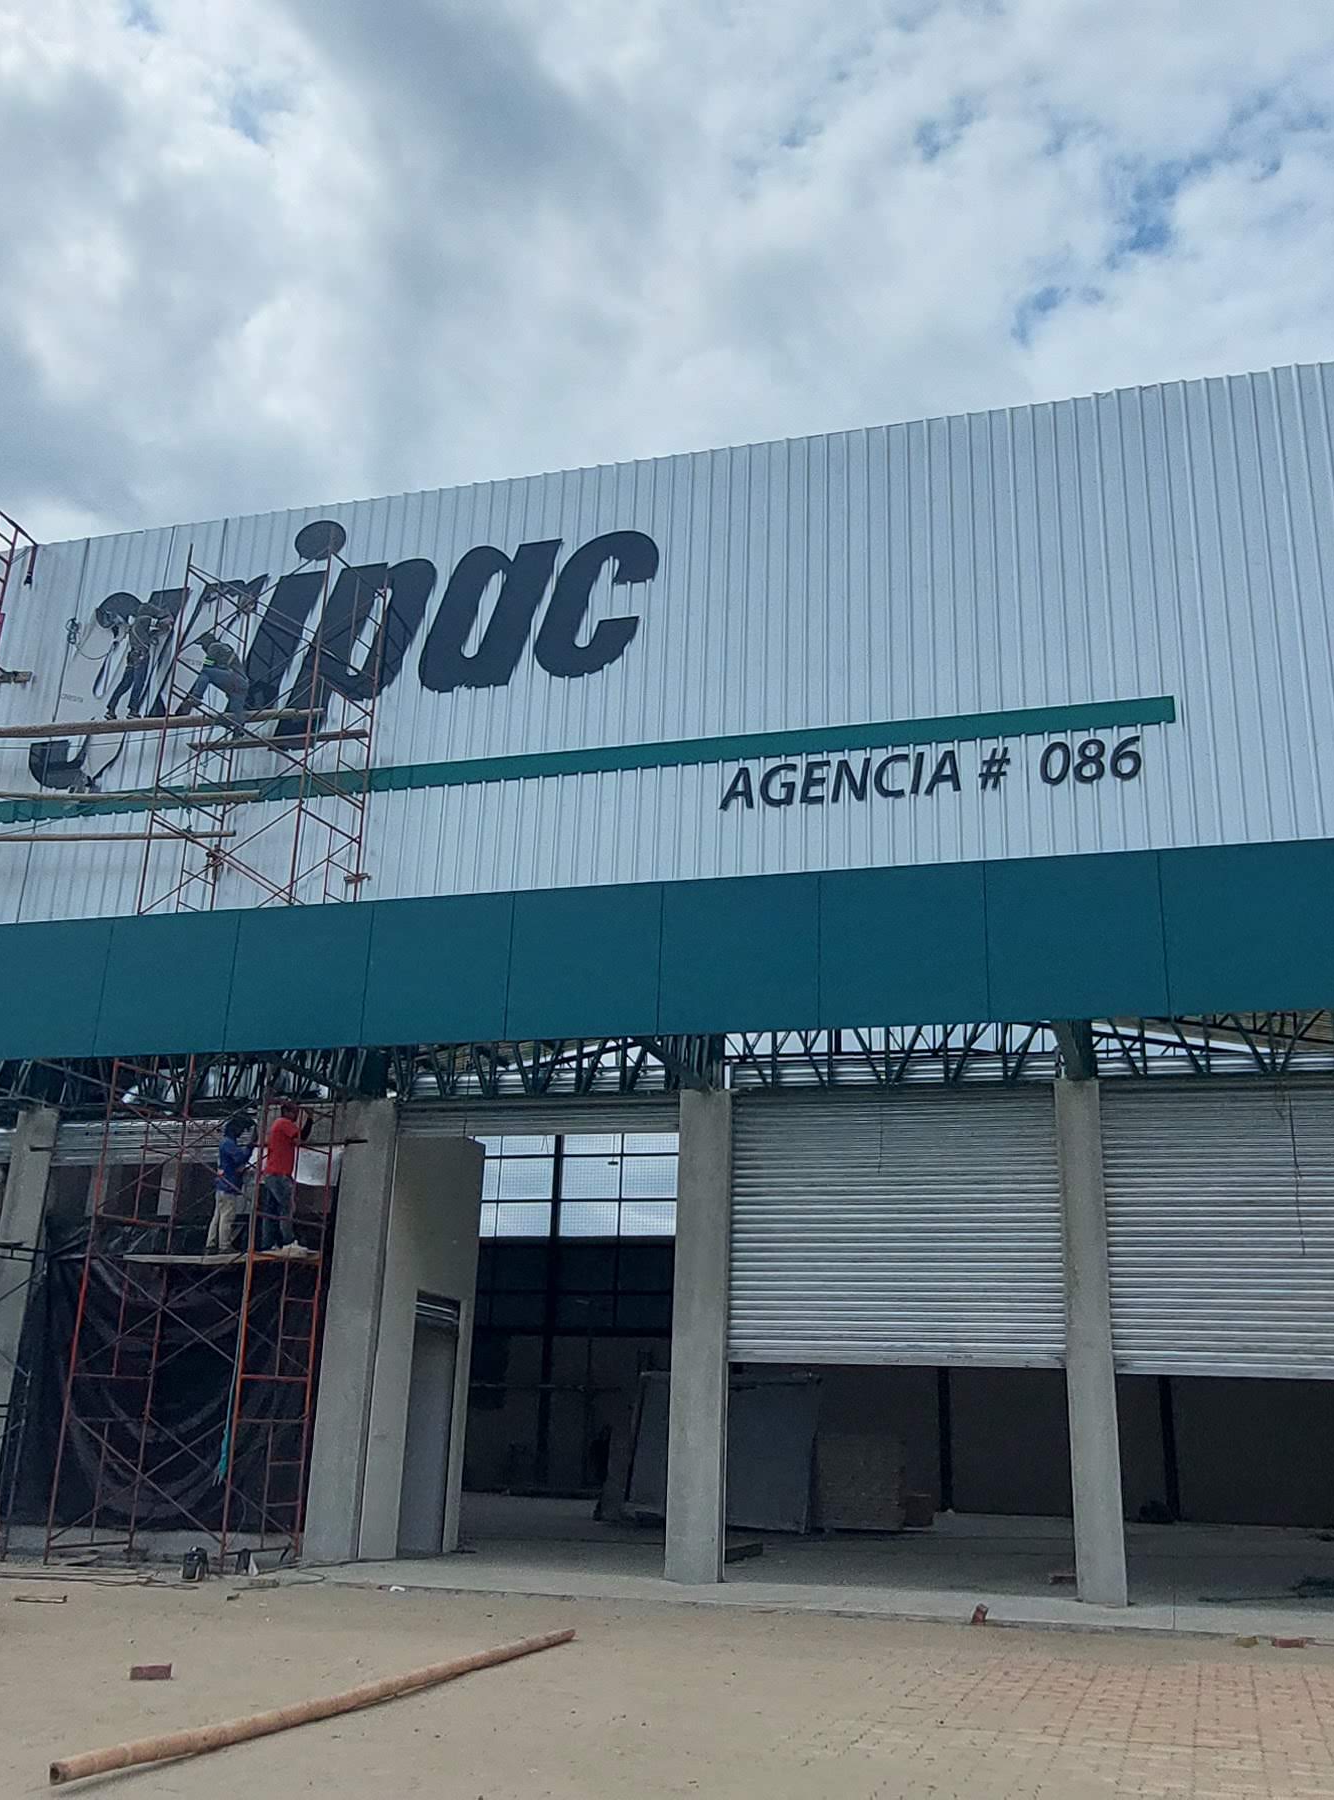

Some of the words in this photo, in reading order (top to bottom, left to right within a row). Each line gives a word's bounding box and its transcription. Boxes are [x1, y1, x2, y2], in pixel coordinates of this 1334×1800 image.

[719, 749, 962, 811] AGENCIA
[978, 746, 1011, 792] #
[1039, 735, 1143, 787] 086
